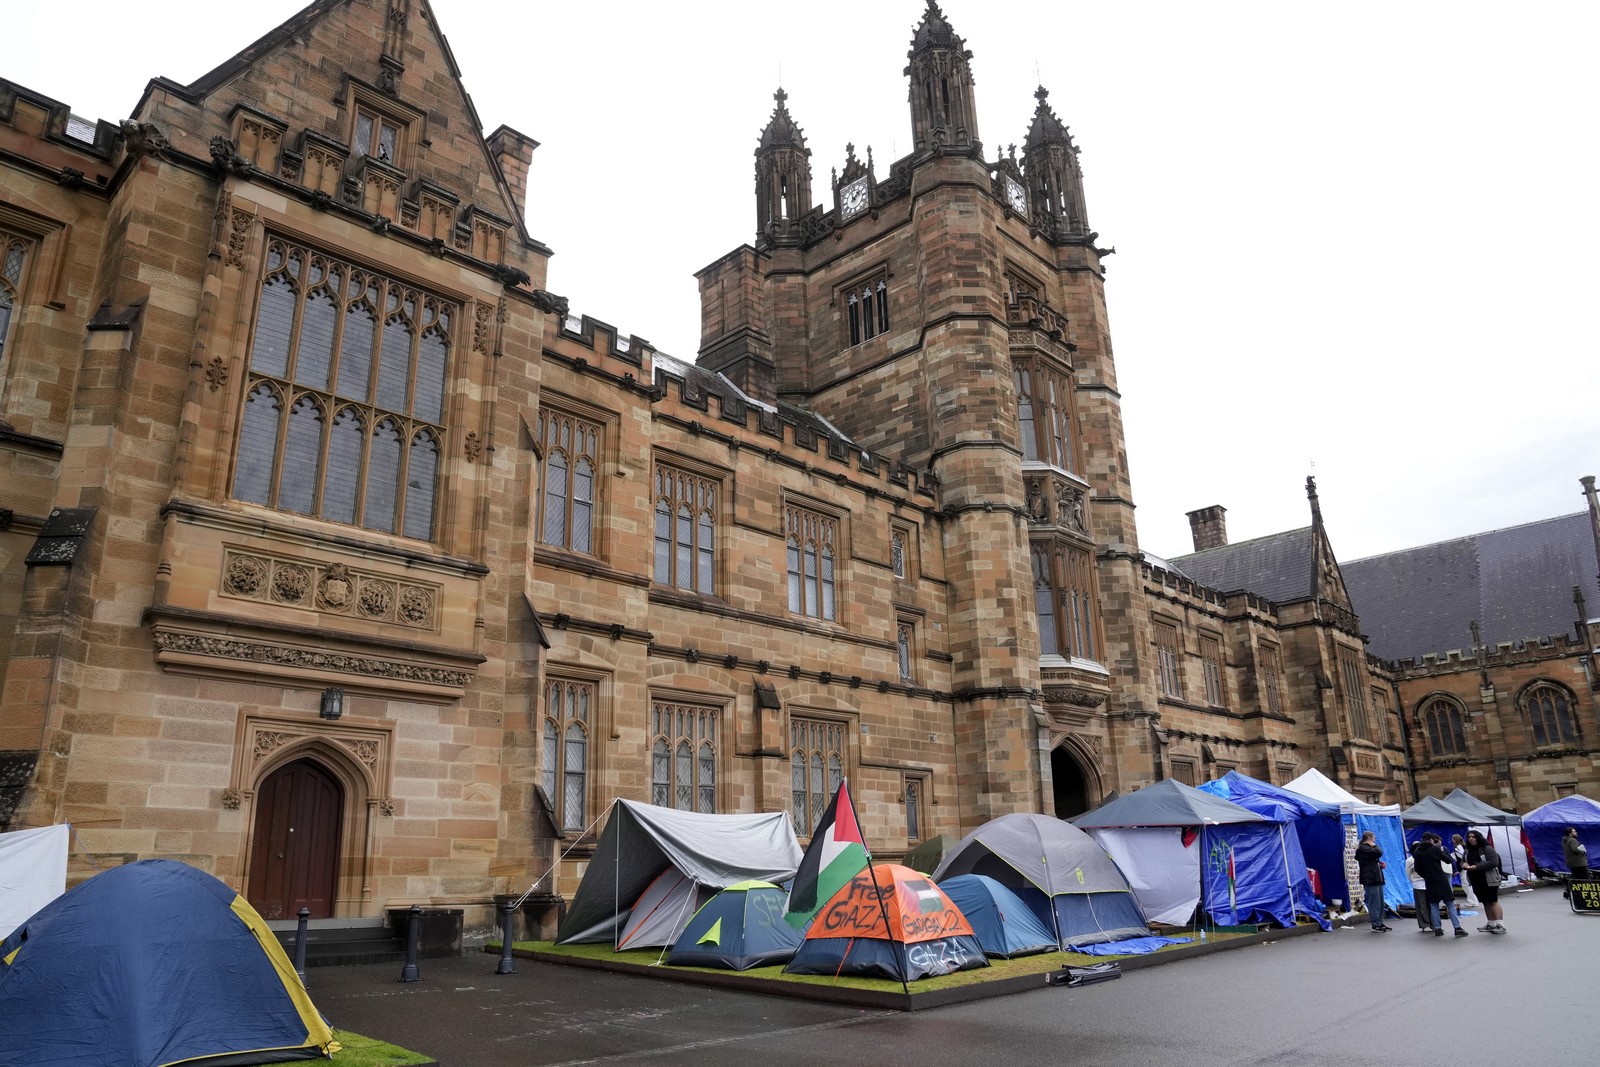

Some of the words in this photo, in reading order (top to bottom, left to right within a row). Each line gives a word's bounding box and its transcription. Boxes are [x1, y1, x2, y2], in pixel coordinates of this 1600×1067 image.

[1581, 891, 1600, 900] FR
[825, 900, 890, 930] GAZA
[908, 937, 968, 967] GAZA
